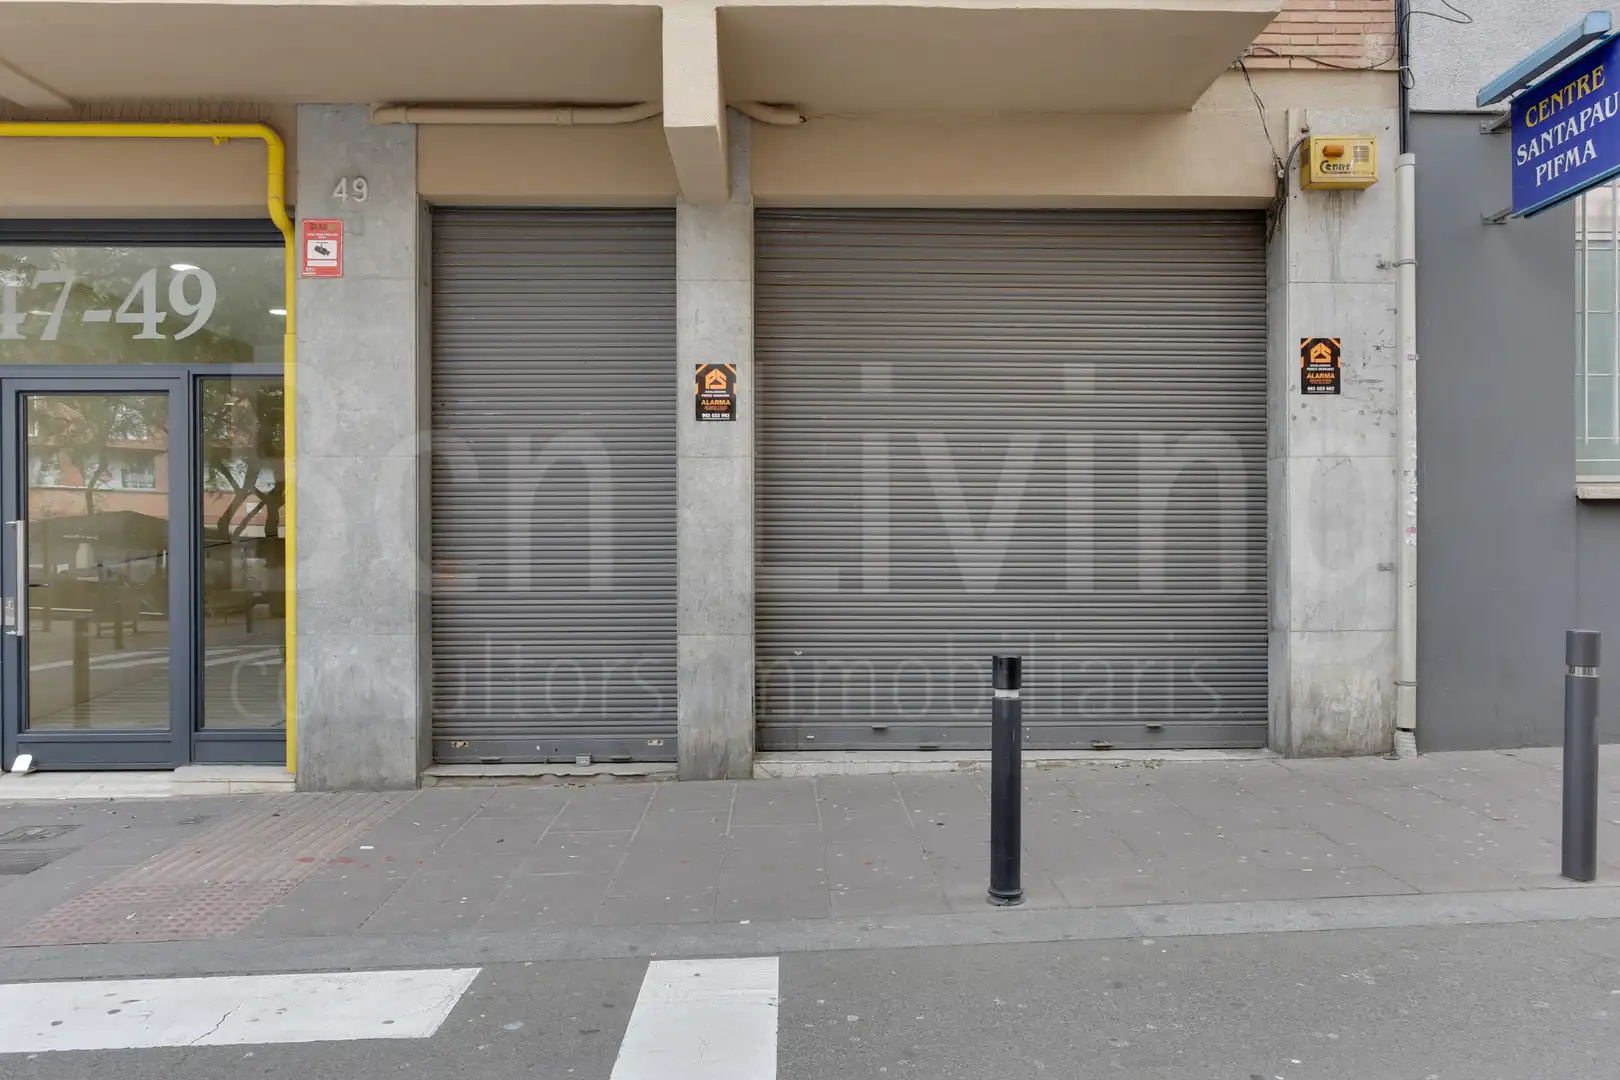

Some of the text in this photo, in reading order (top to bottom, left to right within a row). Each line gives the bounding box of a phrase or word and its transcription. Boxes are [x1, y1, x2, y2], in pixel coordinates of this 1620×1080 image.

[1525, 64, 1606, 128] CENTRE
[1516, 91, 1620, 166] SANTAPAU
[333, 177, 368, 203] 49
[1536, 138, 1598, 187] PIFMA
